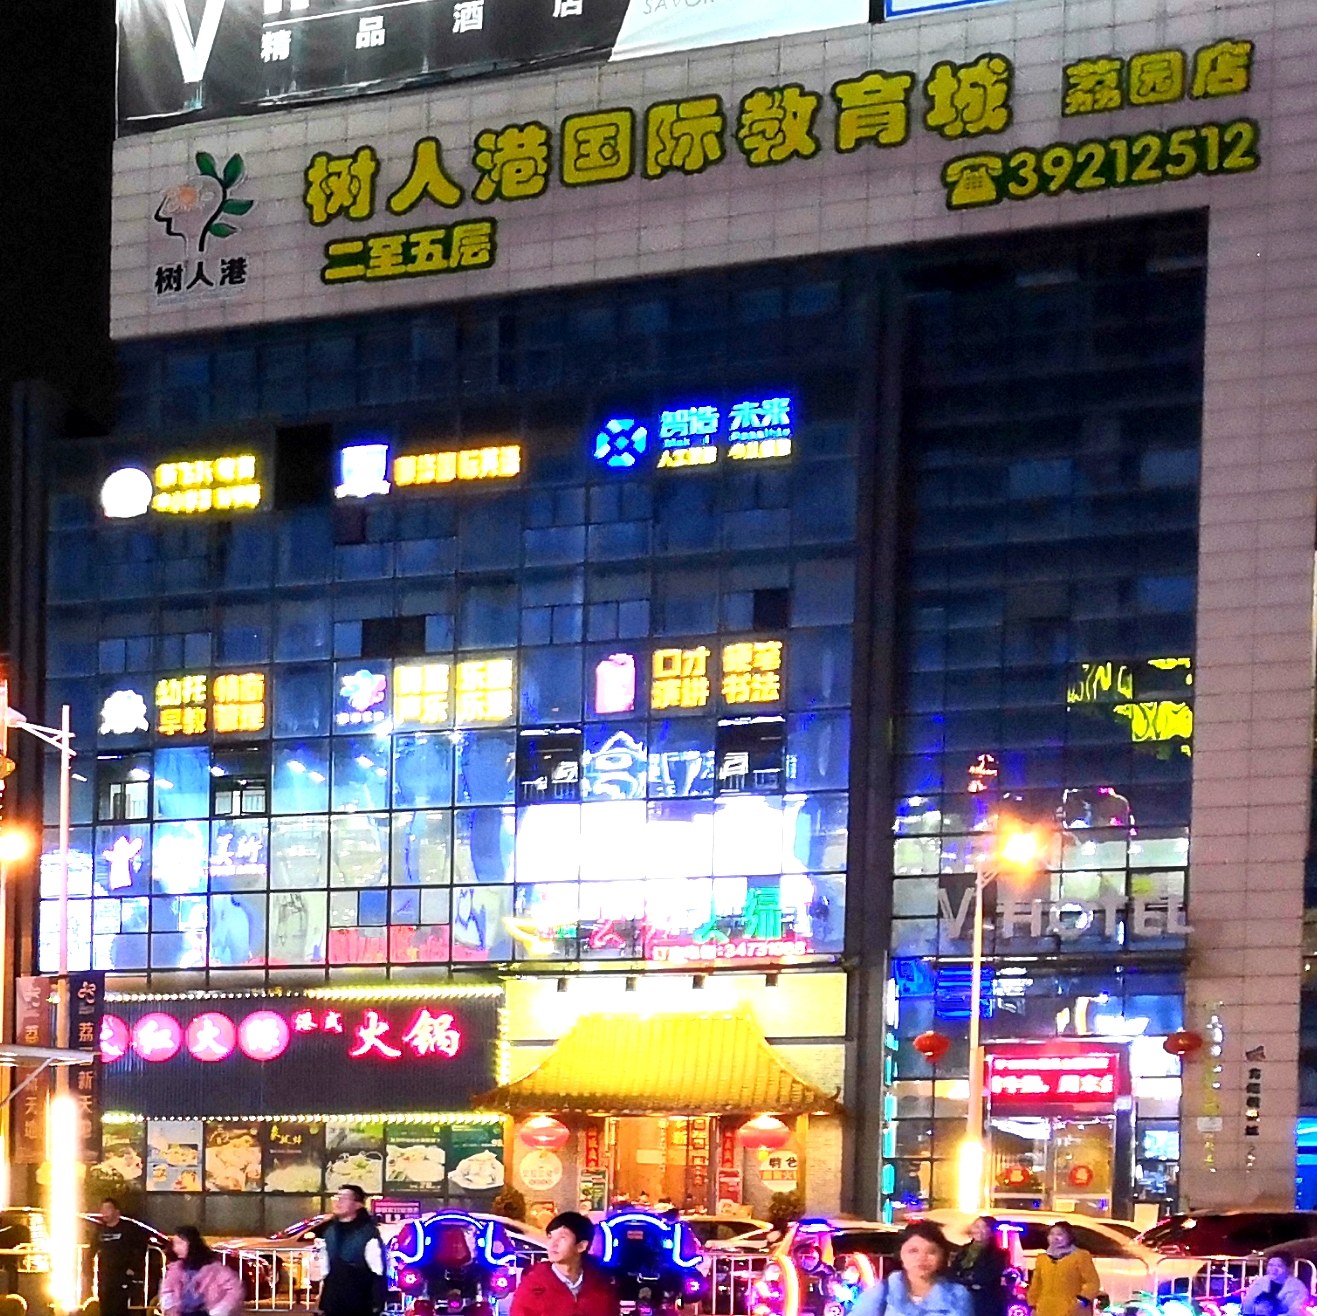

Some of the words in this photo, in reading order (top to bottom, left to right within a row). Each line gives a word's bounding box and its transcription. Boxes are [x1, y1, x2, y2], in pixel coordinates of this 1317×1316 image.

[306, 56, 1014, 226] 树人港国际教育城
[1064, 40, 1254, 117] 荔园店
[1008, 121, 1256, 197] 39212512
[155, 258, 248, 294] 树人港
[323, 221, 493, 280] 二至五层
[728, 398, 792, 430] 未来
[653, 645, 711, 679] 口才
[157, 706, 207, 735] 早教
[937, 887, 976, 938] V
[1001, 888, 1196, 942] HOTEL
[349, 1008, 462, 1059] 火锅
